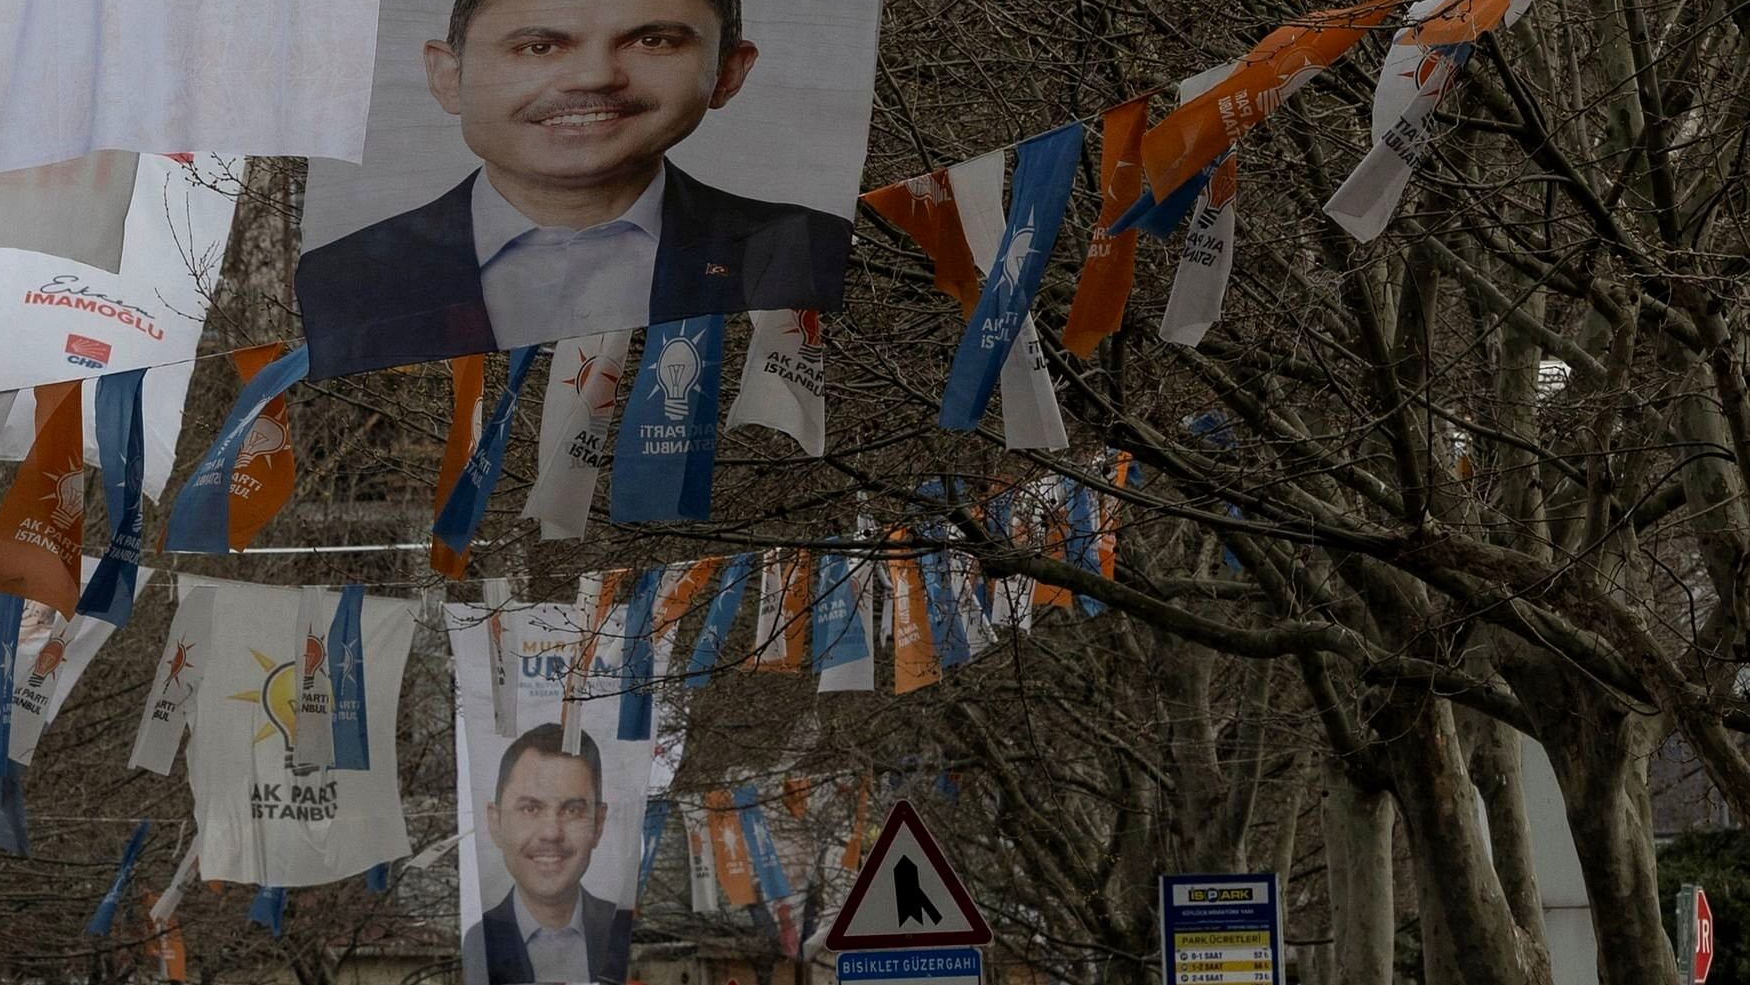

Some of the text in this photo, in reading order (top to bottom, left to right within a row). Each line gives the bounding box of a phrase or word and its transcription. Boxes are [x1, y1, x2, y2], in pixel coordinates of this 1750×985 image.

[25, 291, 164, 341] İMAMOĞLU
[67, 355, 104, 369] CHP
[767, 351, 793, 367] AK
[575, 430, 601, 450] AK
[19, 517, 42, 533] AK
[251, 781, 338, 805] AK PART
[1182, 935, 1207, 944] PARK
[842, 955, 977, 974] BİSİKLET GÜZERGAHI
